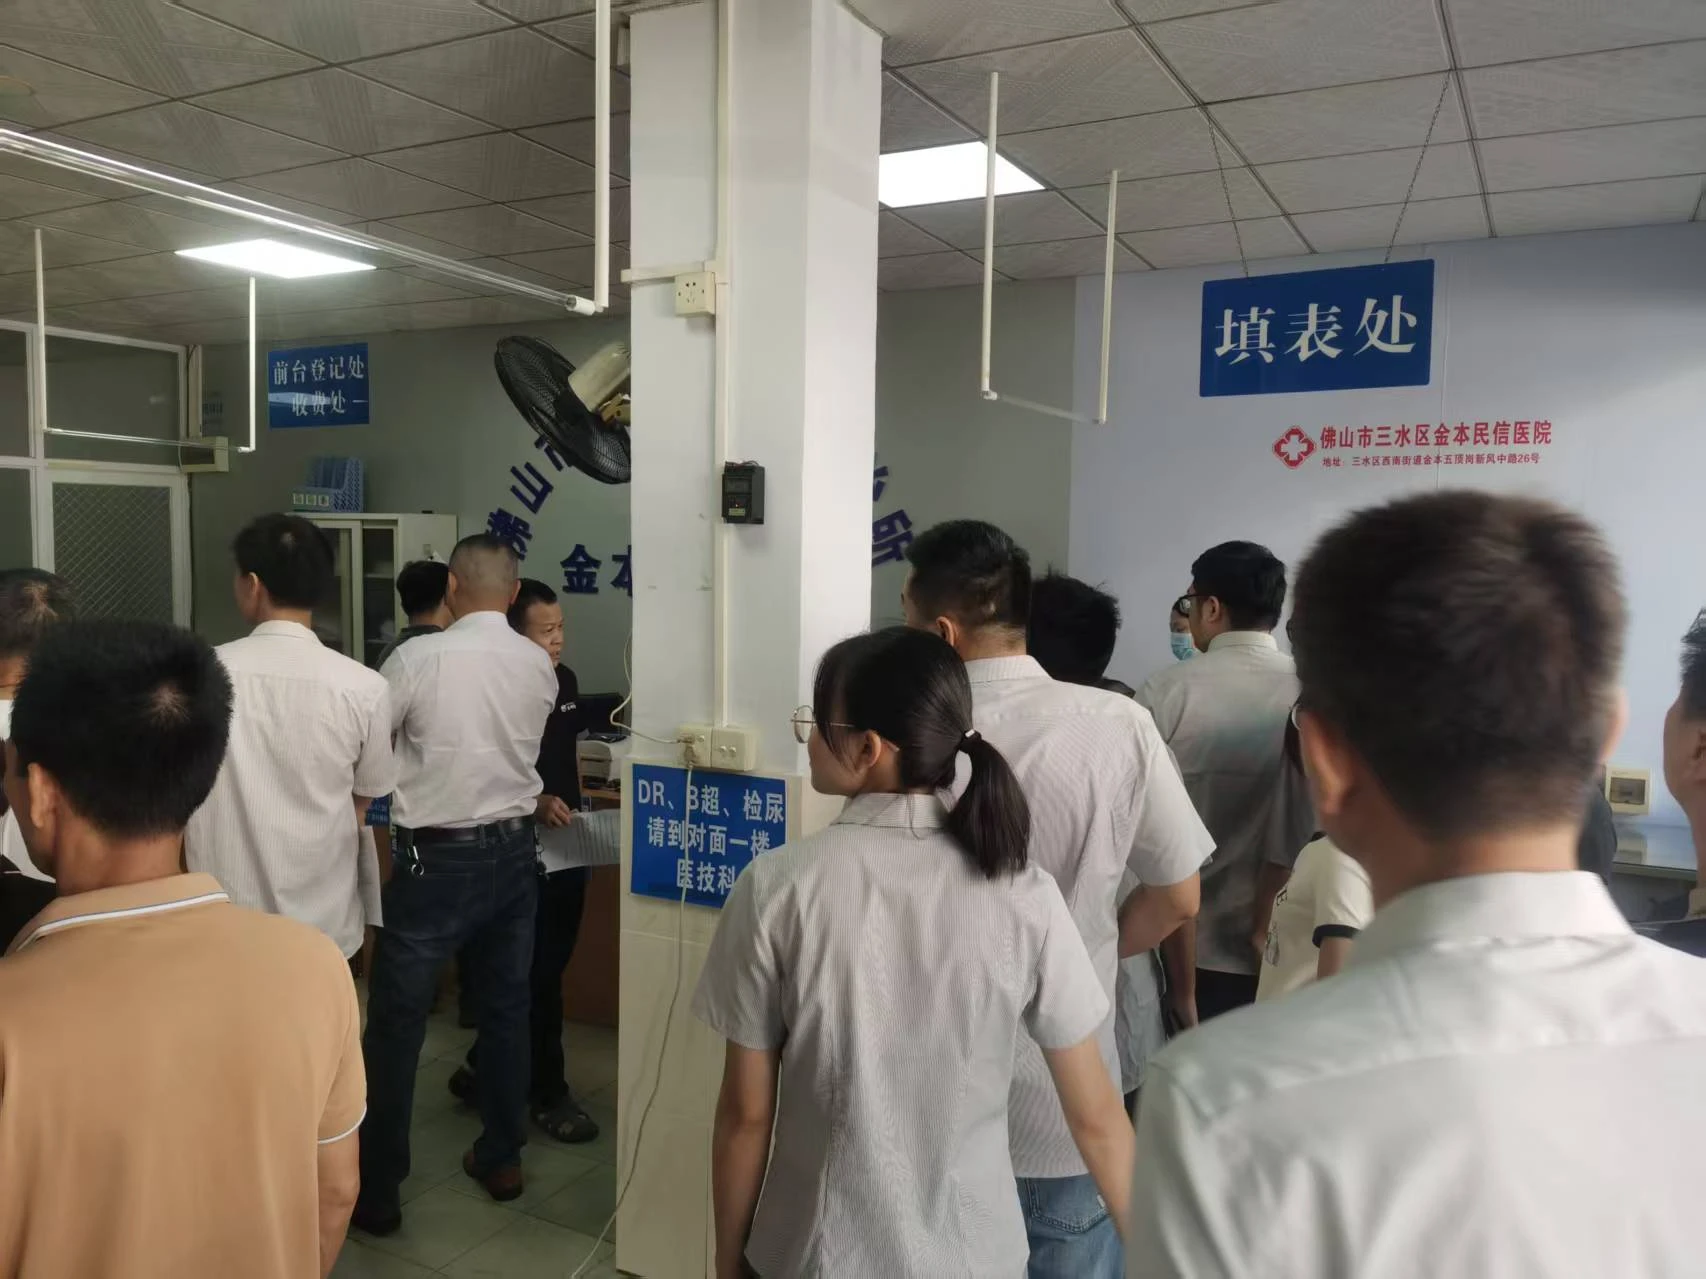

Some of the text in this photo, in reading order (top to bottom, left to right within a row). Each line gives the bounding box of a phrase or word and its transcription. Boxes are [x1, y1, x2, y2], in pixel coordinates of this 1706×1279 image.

[1214, 295, 1417, 365] 填表处
[273, 354, 364, 385] 前台登记处
[292, 389, 346, 416] 收费处
[1320, 420, 1552, 449] 佛山市三水区金本民信医院
[647, 816, 771, 858] 请到对面一楼
[676, 858, 736, 896] 医技科
